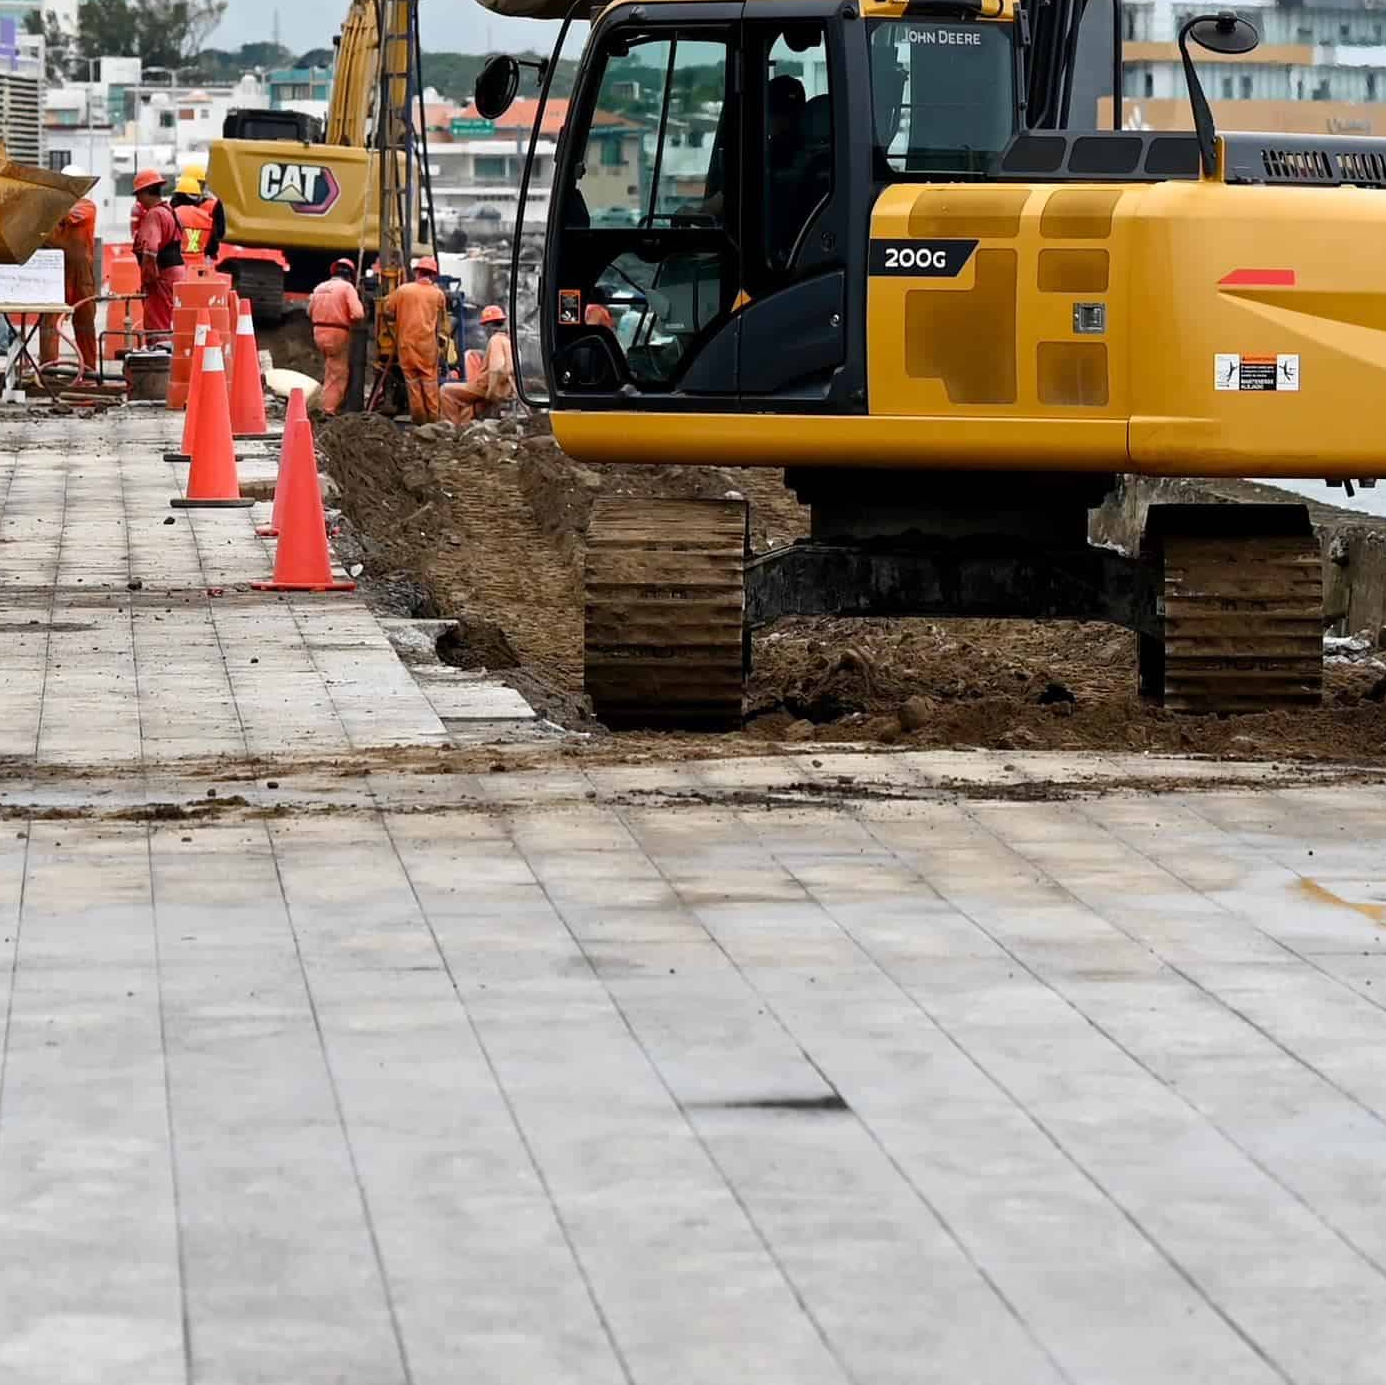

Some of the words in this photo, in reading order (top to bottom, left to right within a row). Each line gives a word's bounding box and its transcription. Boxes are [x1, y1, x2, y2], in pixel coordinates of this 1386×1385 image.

[901, 28, 935, 44] JOHN
[938, 30, 981, 45] DEERE
[260, 163, 321, 203] CAT
[885, 248, 946, 268] 200G
